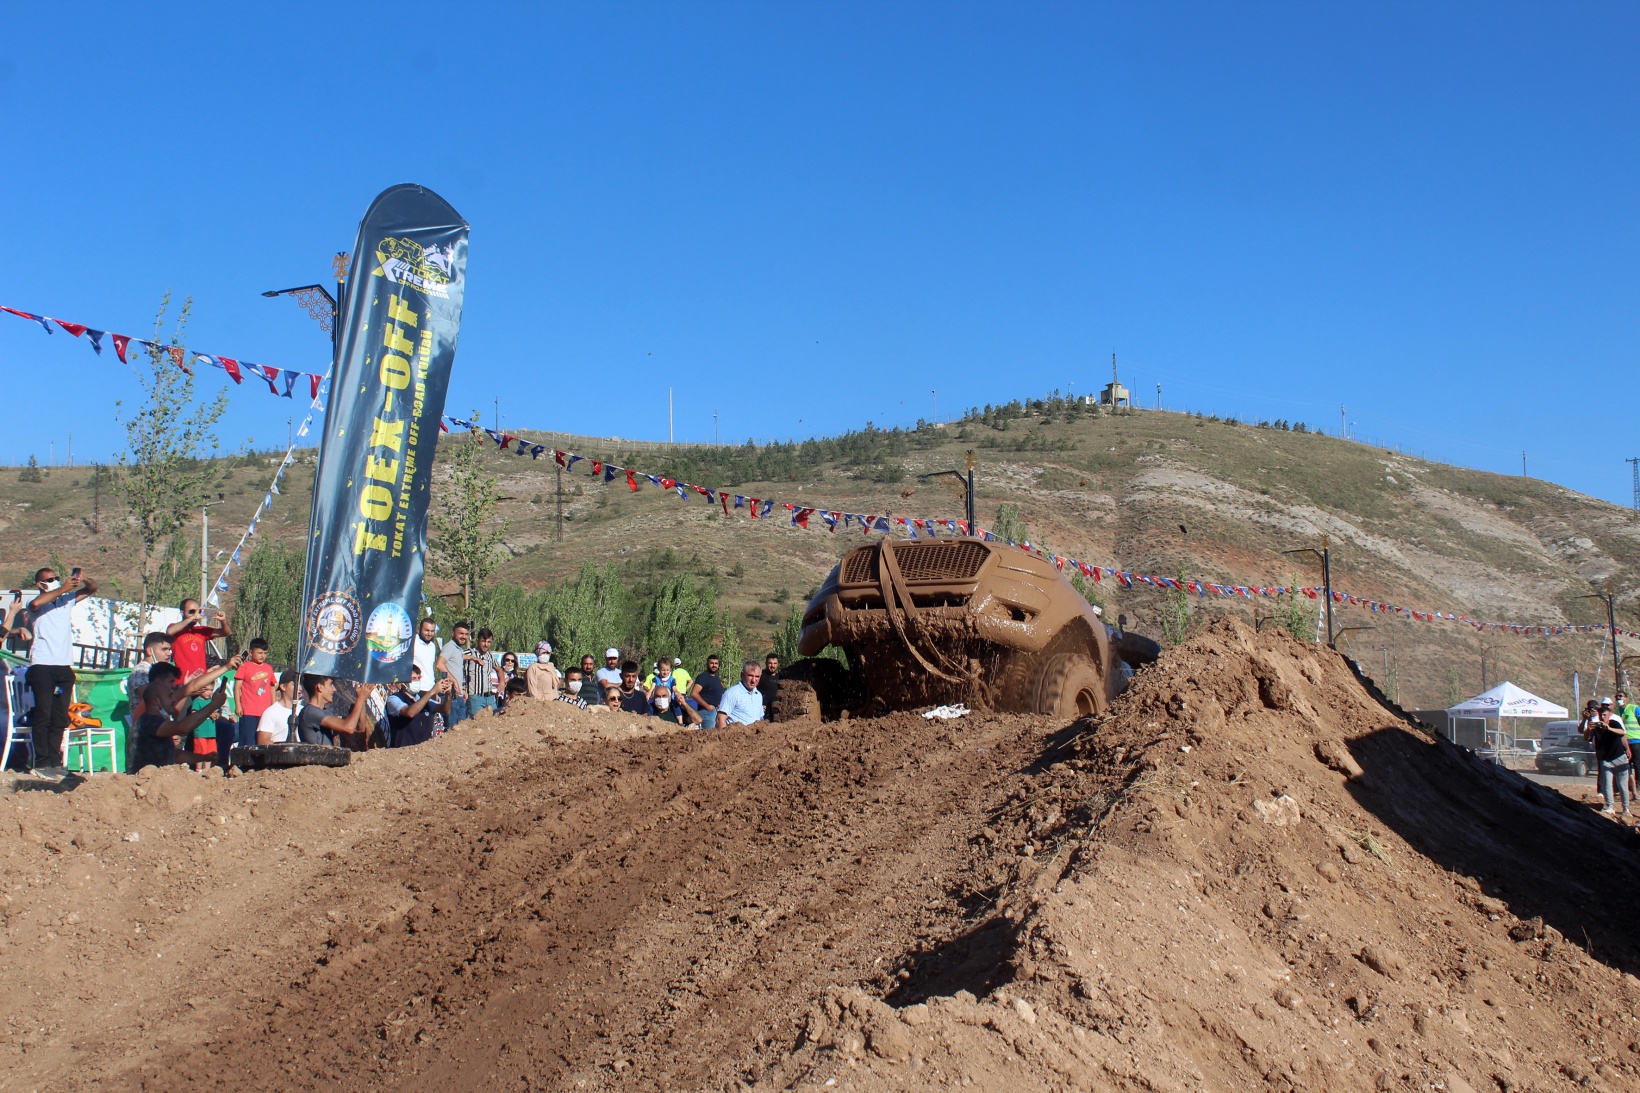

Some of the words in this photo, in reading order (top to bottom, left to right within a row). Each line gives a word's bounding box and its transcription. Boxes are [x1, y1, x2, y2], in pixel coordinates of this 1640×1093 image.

[412, 265, 450, 286] TOKAT
[416, 329, 433, 380] KULÜBÜ
[354, 293, 418, 556] TOEX-OFF
[408, 382, 426, 446] OFF-ROAD
[398, 449, 417, 509] EXTREME
[391, 513, 407, 558] TOKAT
[312, 596, 335, 617] EXTREME
[335, 596, 347, 605] OFF
[346, 603, 359, 618] ROAD
[321, 638, 349, 651] TOEX
